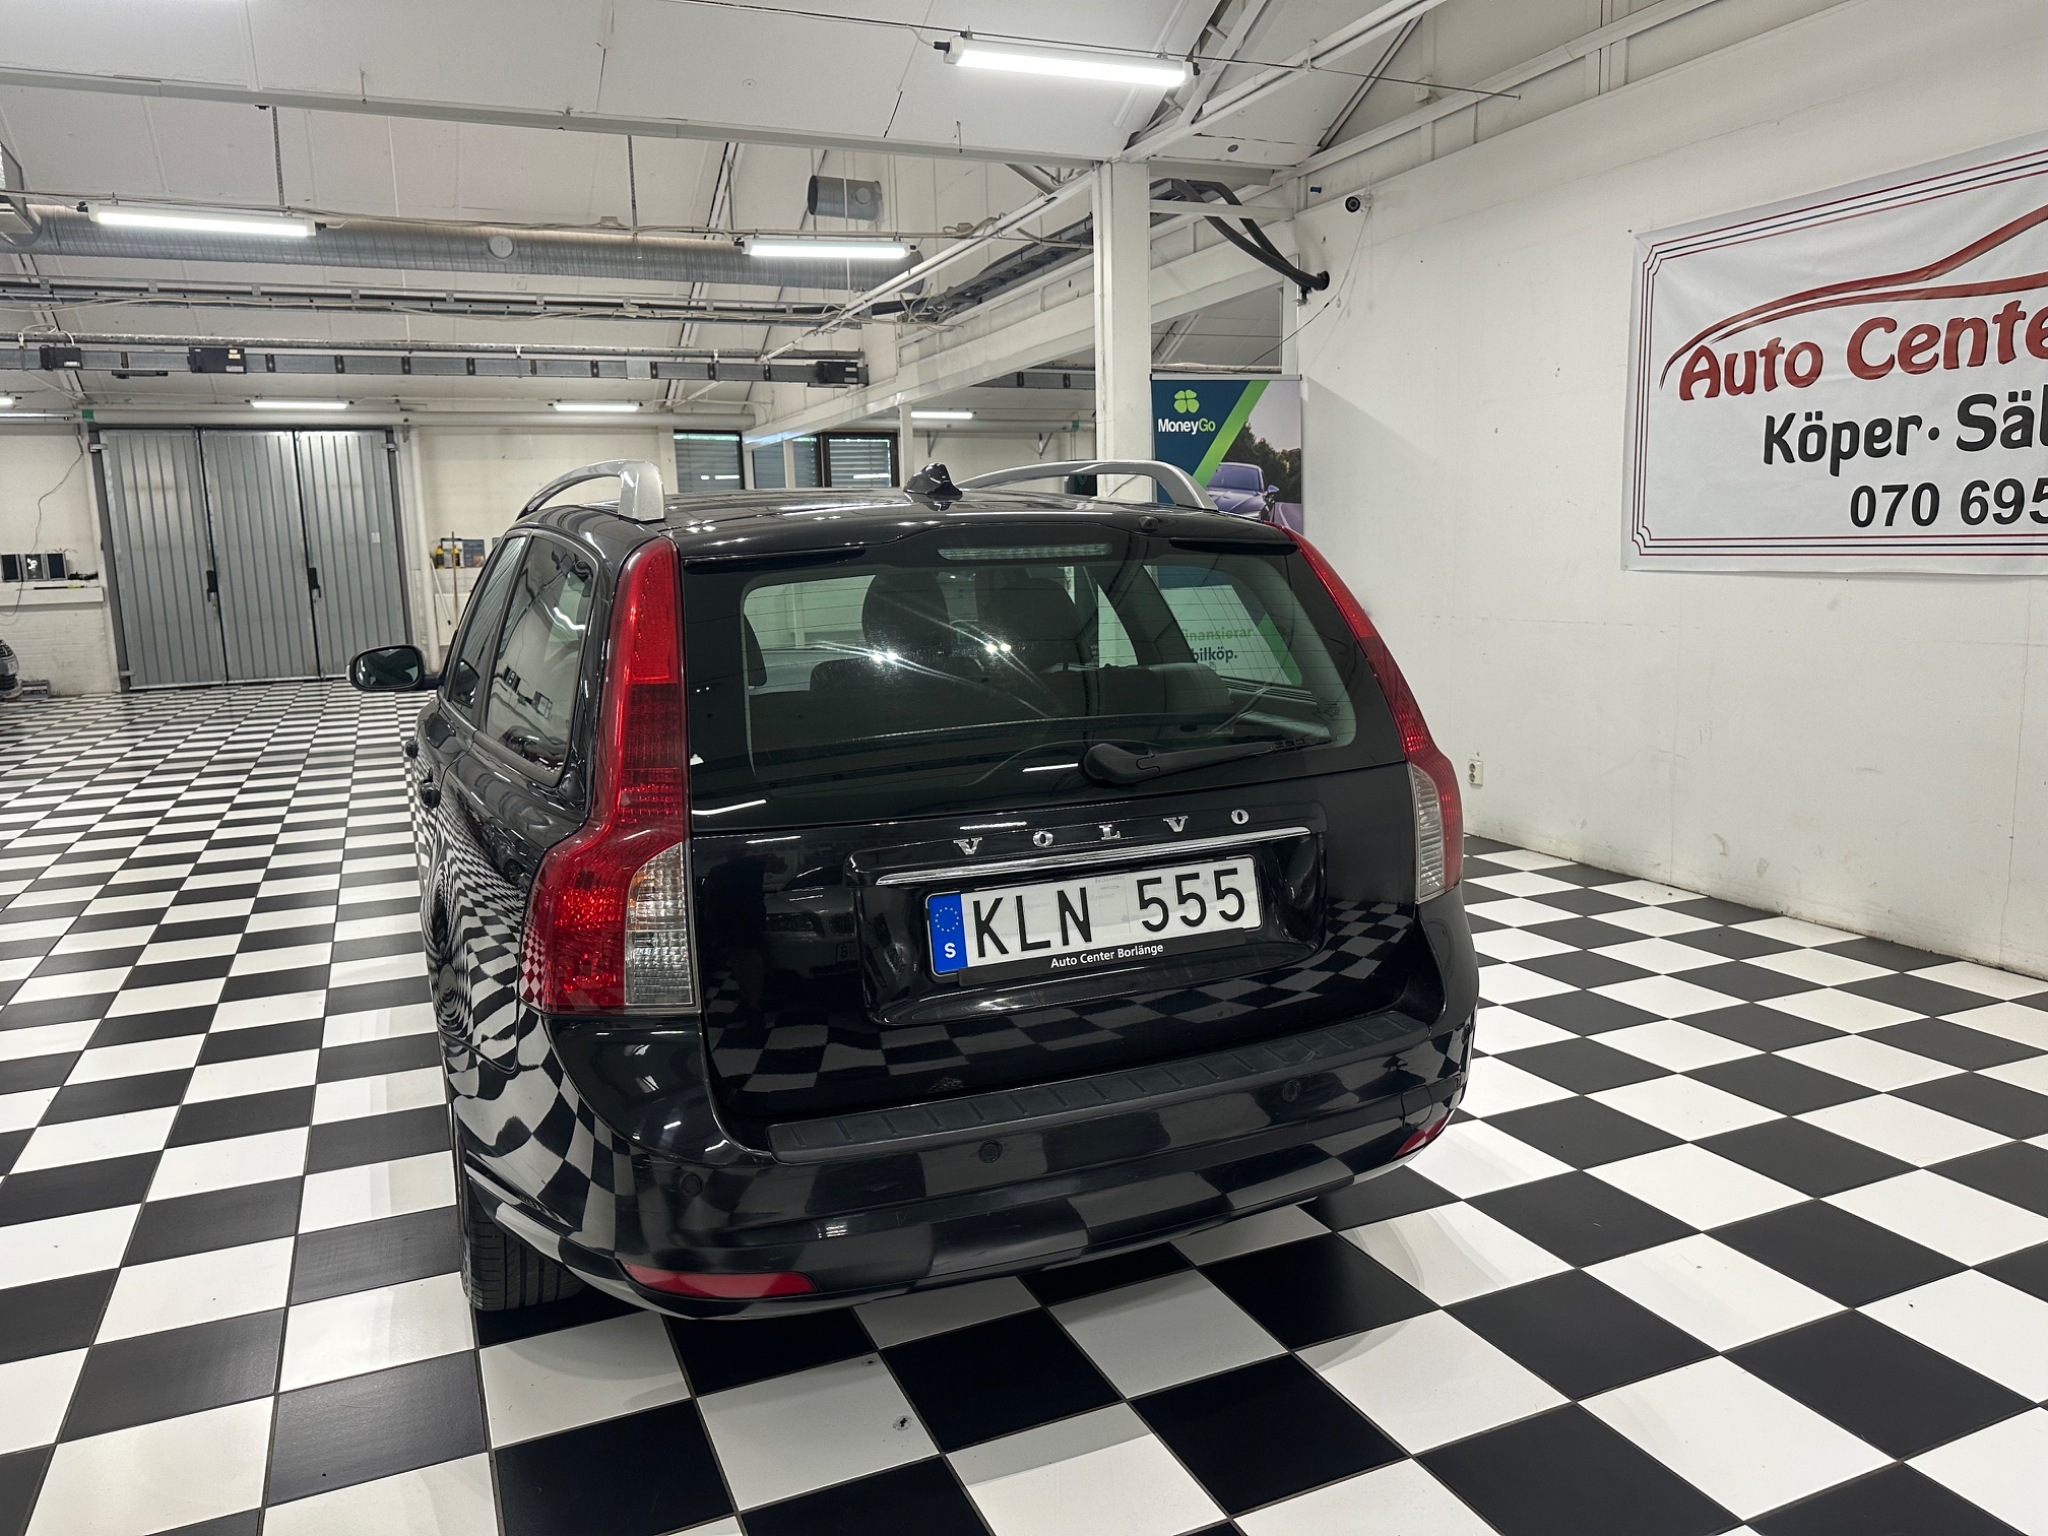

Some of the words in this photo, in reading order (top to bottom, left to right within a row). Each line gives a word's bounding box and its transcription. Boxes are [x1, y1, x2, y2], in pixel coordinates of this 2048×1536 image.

[1678, 337, 1823, 400] Auto
[1157, 418, 1216, 435] MoneyGo
[1850, 482, 1939, 527] 070
[1960, 478, 2048, 525] 695
[953, 809, 1249, 855] VOLVO
[972, 887, 1092, 958] KLN
[1136, 867, 1245, 932] 555
[944, 942, 956, 958] S
[1050, 956, 1078, 969] Auto
[1080, 950, 1115, 964] Center
[1117, 944, 1164, 958] Borlänge
